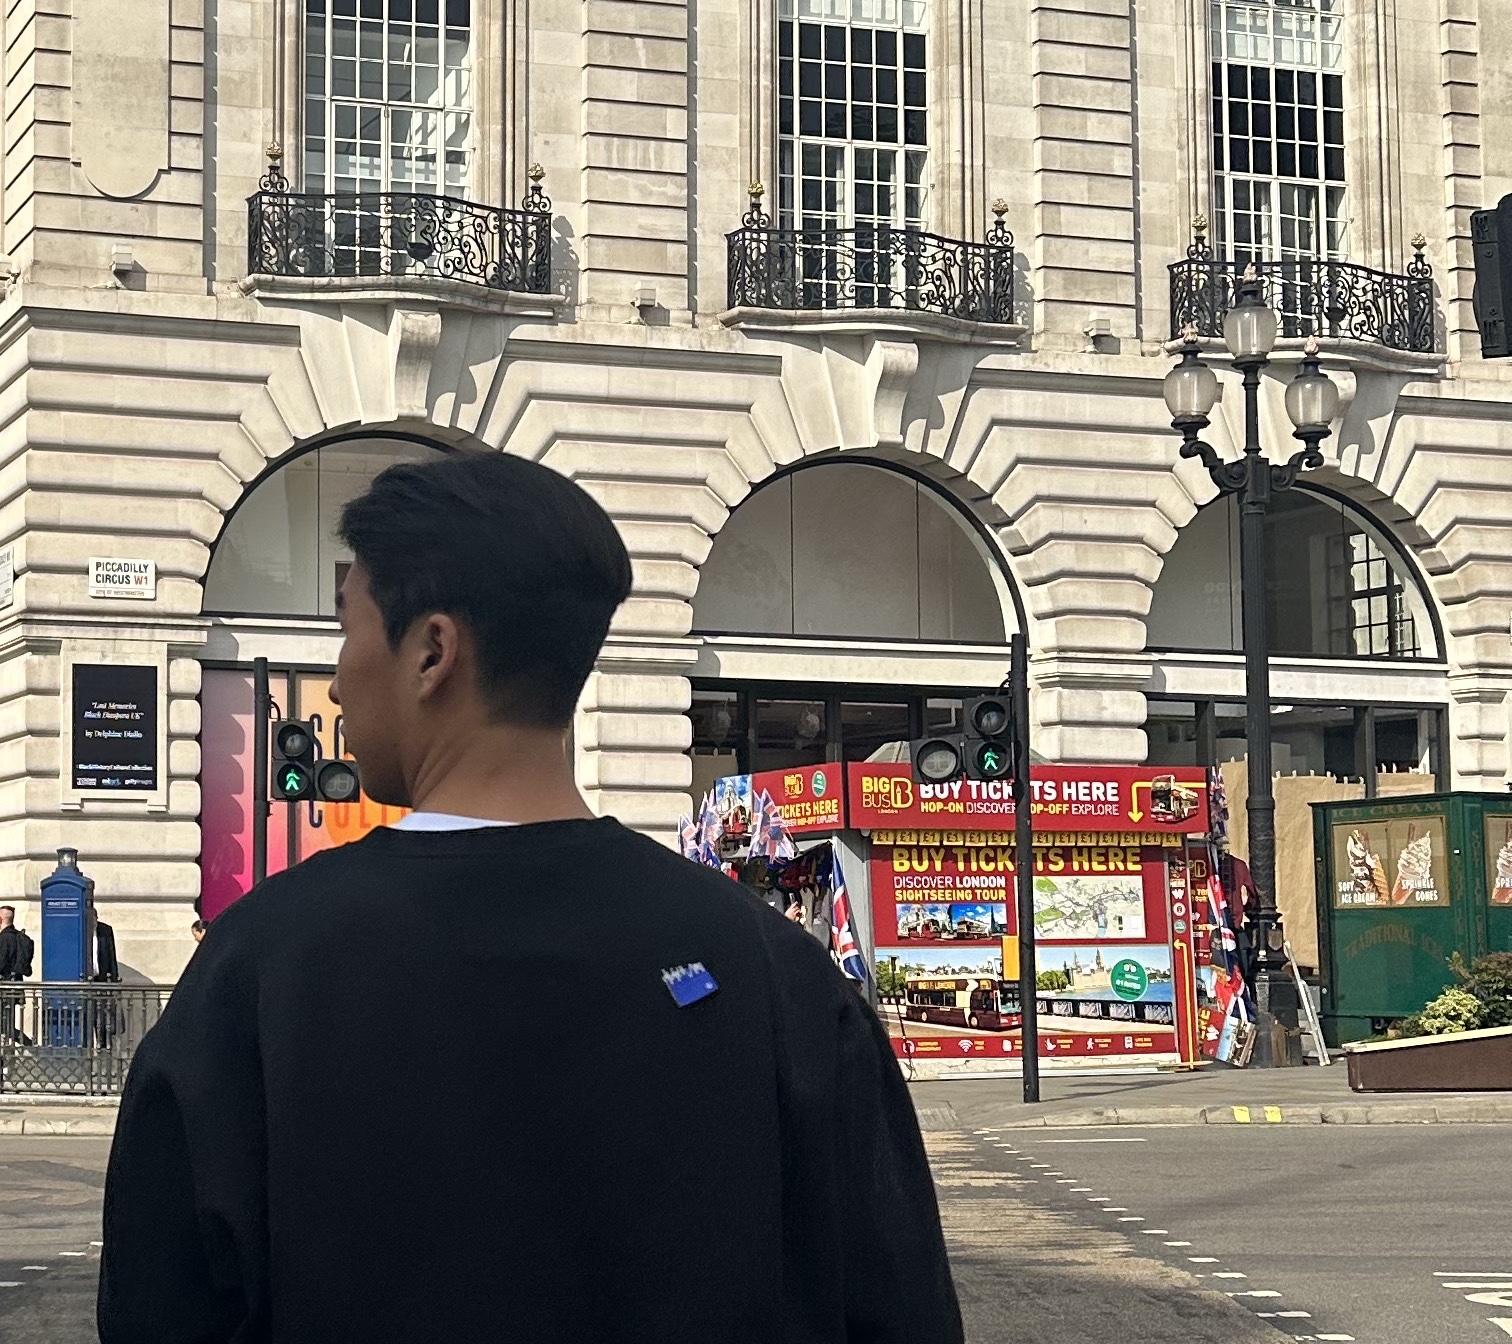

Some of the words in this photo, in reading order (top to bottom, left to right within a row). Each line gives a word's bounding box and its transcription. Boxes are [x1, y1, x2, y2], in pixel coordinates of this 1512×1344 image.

[95, 561, 149, 574] PICCADILLY
[95, 573, 131, 585] CIRCUS
[134, 575, 148, 586] W1
[861, 776, 891, 794] BIG
[919, 780, 963, 800] BUY
[966, 779, 1057, 802] TICKTS
[1062, 781, 1120, 802] HERE
[862, 793, 891, 808] BUS
[776, 802, 812, 819] TICKETS
[812, 799, 839, 816] HERE
[920, 801, 965, 814] HOP-ON
[1028, 803, 1070, 815] OP-OFF
[1071, 804, 1120, 816] EXPLORE
[1369, 802, 1443, 818] CREAM
[876, 832, 889, 843] £1
[899, 832, 913, 843] £1
[923, 832, 936, 843] £1
[946, 832, 959, 843] £1
[968, 832, 982, 843] £1
[991, 832, 1004, 843] £1
[1036, 832, 1049, 843] £1
[1058, 832, 1071, 843] £1
[1082, 832, 1094, 843] £1
[1103, 832, 1114, 843] £1
[1123, 832, 1136, 843] £1
[1144, 832, 1157, 843] £1
[1165, 832, 1178, 843] £1
[892, 847, 946, 873] BUY
[951, 847, 1065, 873] TICKTS
[1071, 847, 1143, 872] HERE
[893, 875, 954, 889] DISCOVER
[955, 875, 1006, 888] LONDON
[1338, 881, 1355, 892] SOFT
[1401, 877, 1435, 890] SPRINKLE
[894, 889, 973, 901] SIGHTSEEING
[974, 889, 1007, 901] TOUR
[1415, 890, 1439, 902] CONES
